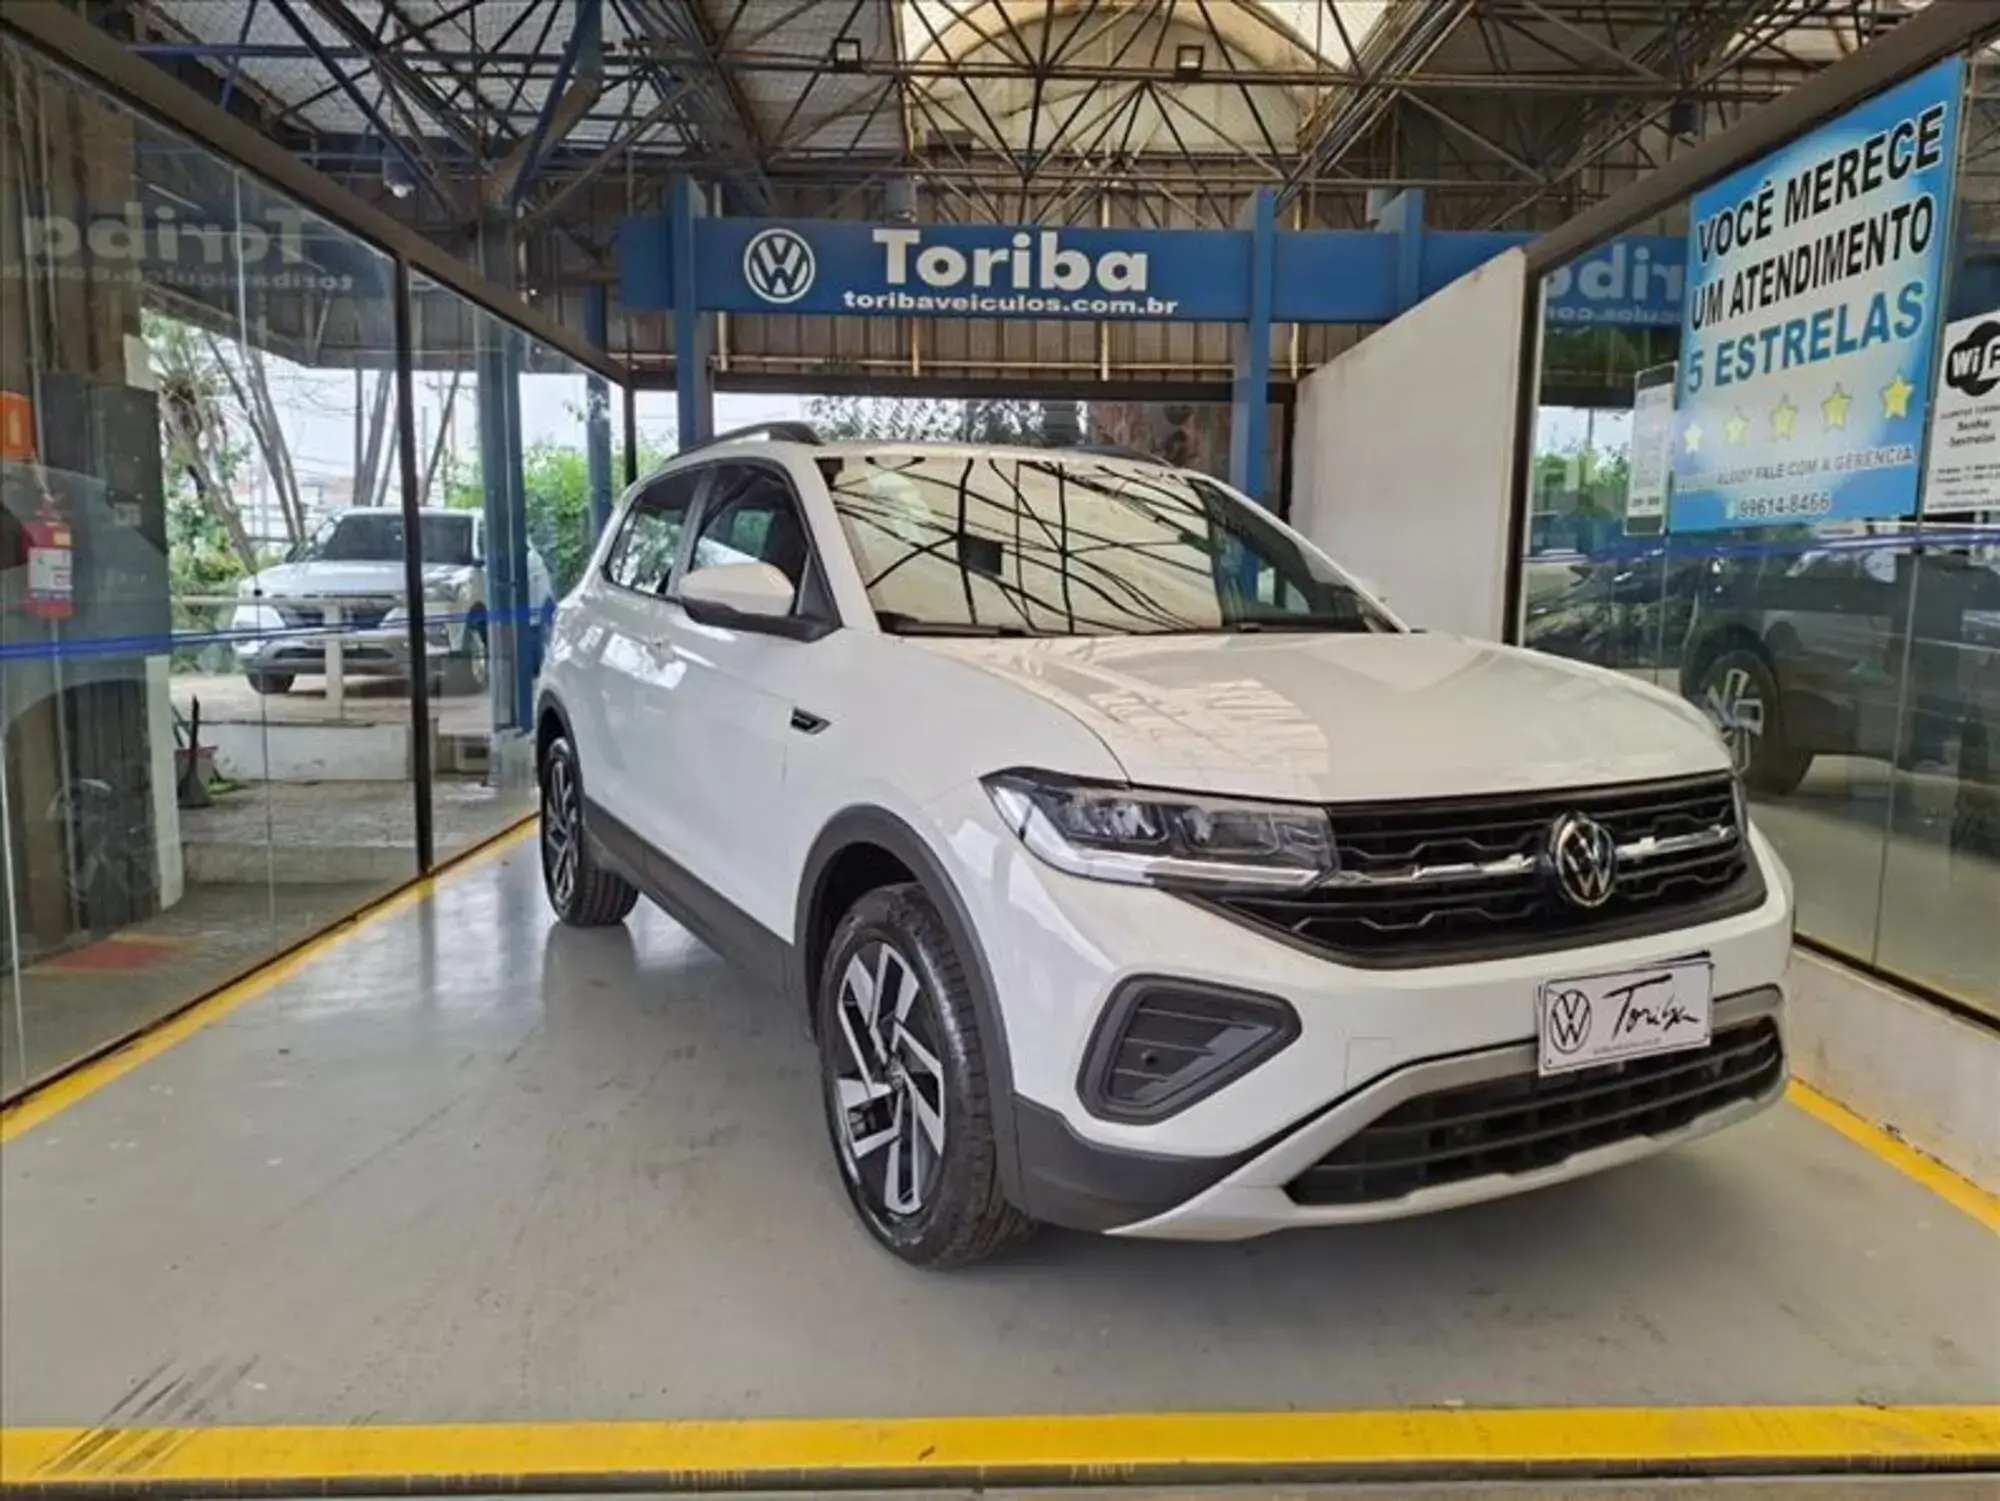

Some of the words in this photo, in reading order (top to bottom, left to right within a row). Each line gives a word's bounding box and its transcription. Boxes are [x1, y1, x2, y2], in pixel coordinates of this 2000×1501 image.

[1784, 105, 1944, 228] MERECE
[843, 290, 1179, 315] toribaveiculos.com.br
[872, 228, 1149, 292] Toriba
[1691, 279, 1725, 332] UM
[1729, 195, 1933, 319] ATENDIMENTO
[1687, 350, 1704, 395] 5
[1715, 281, 1925, 387] ESTRELAS
